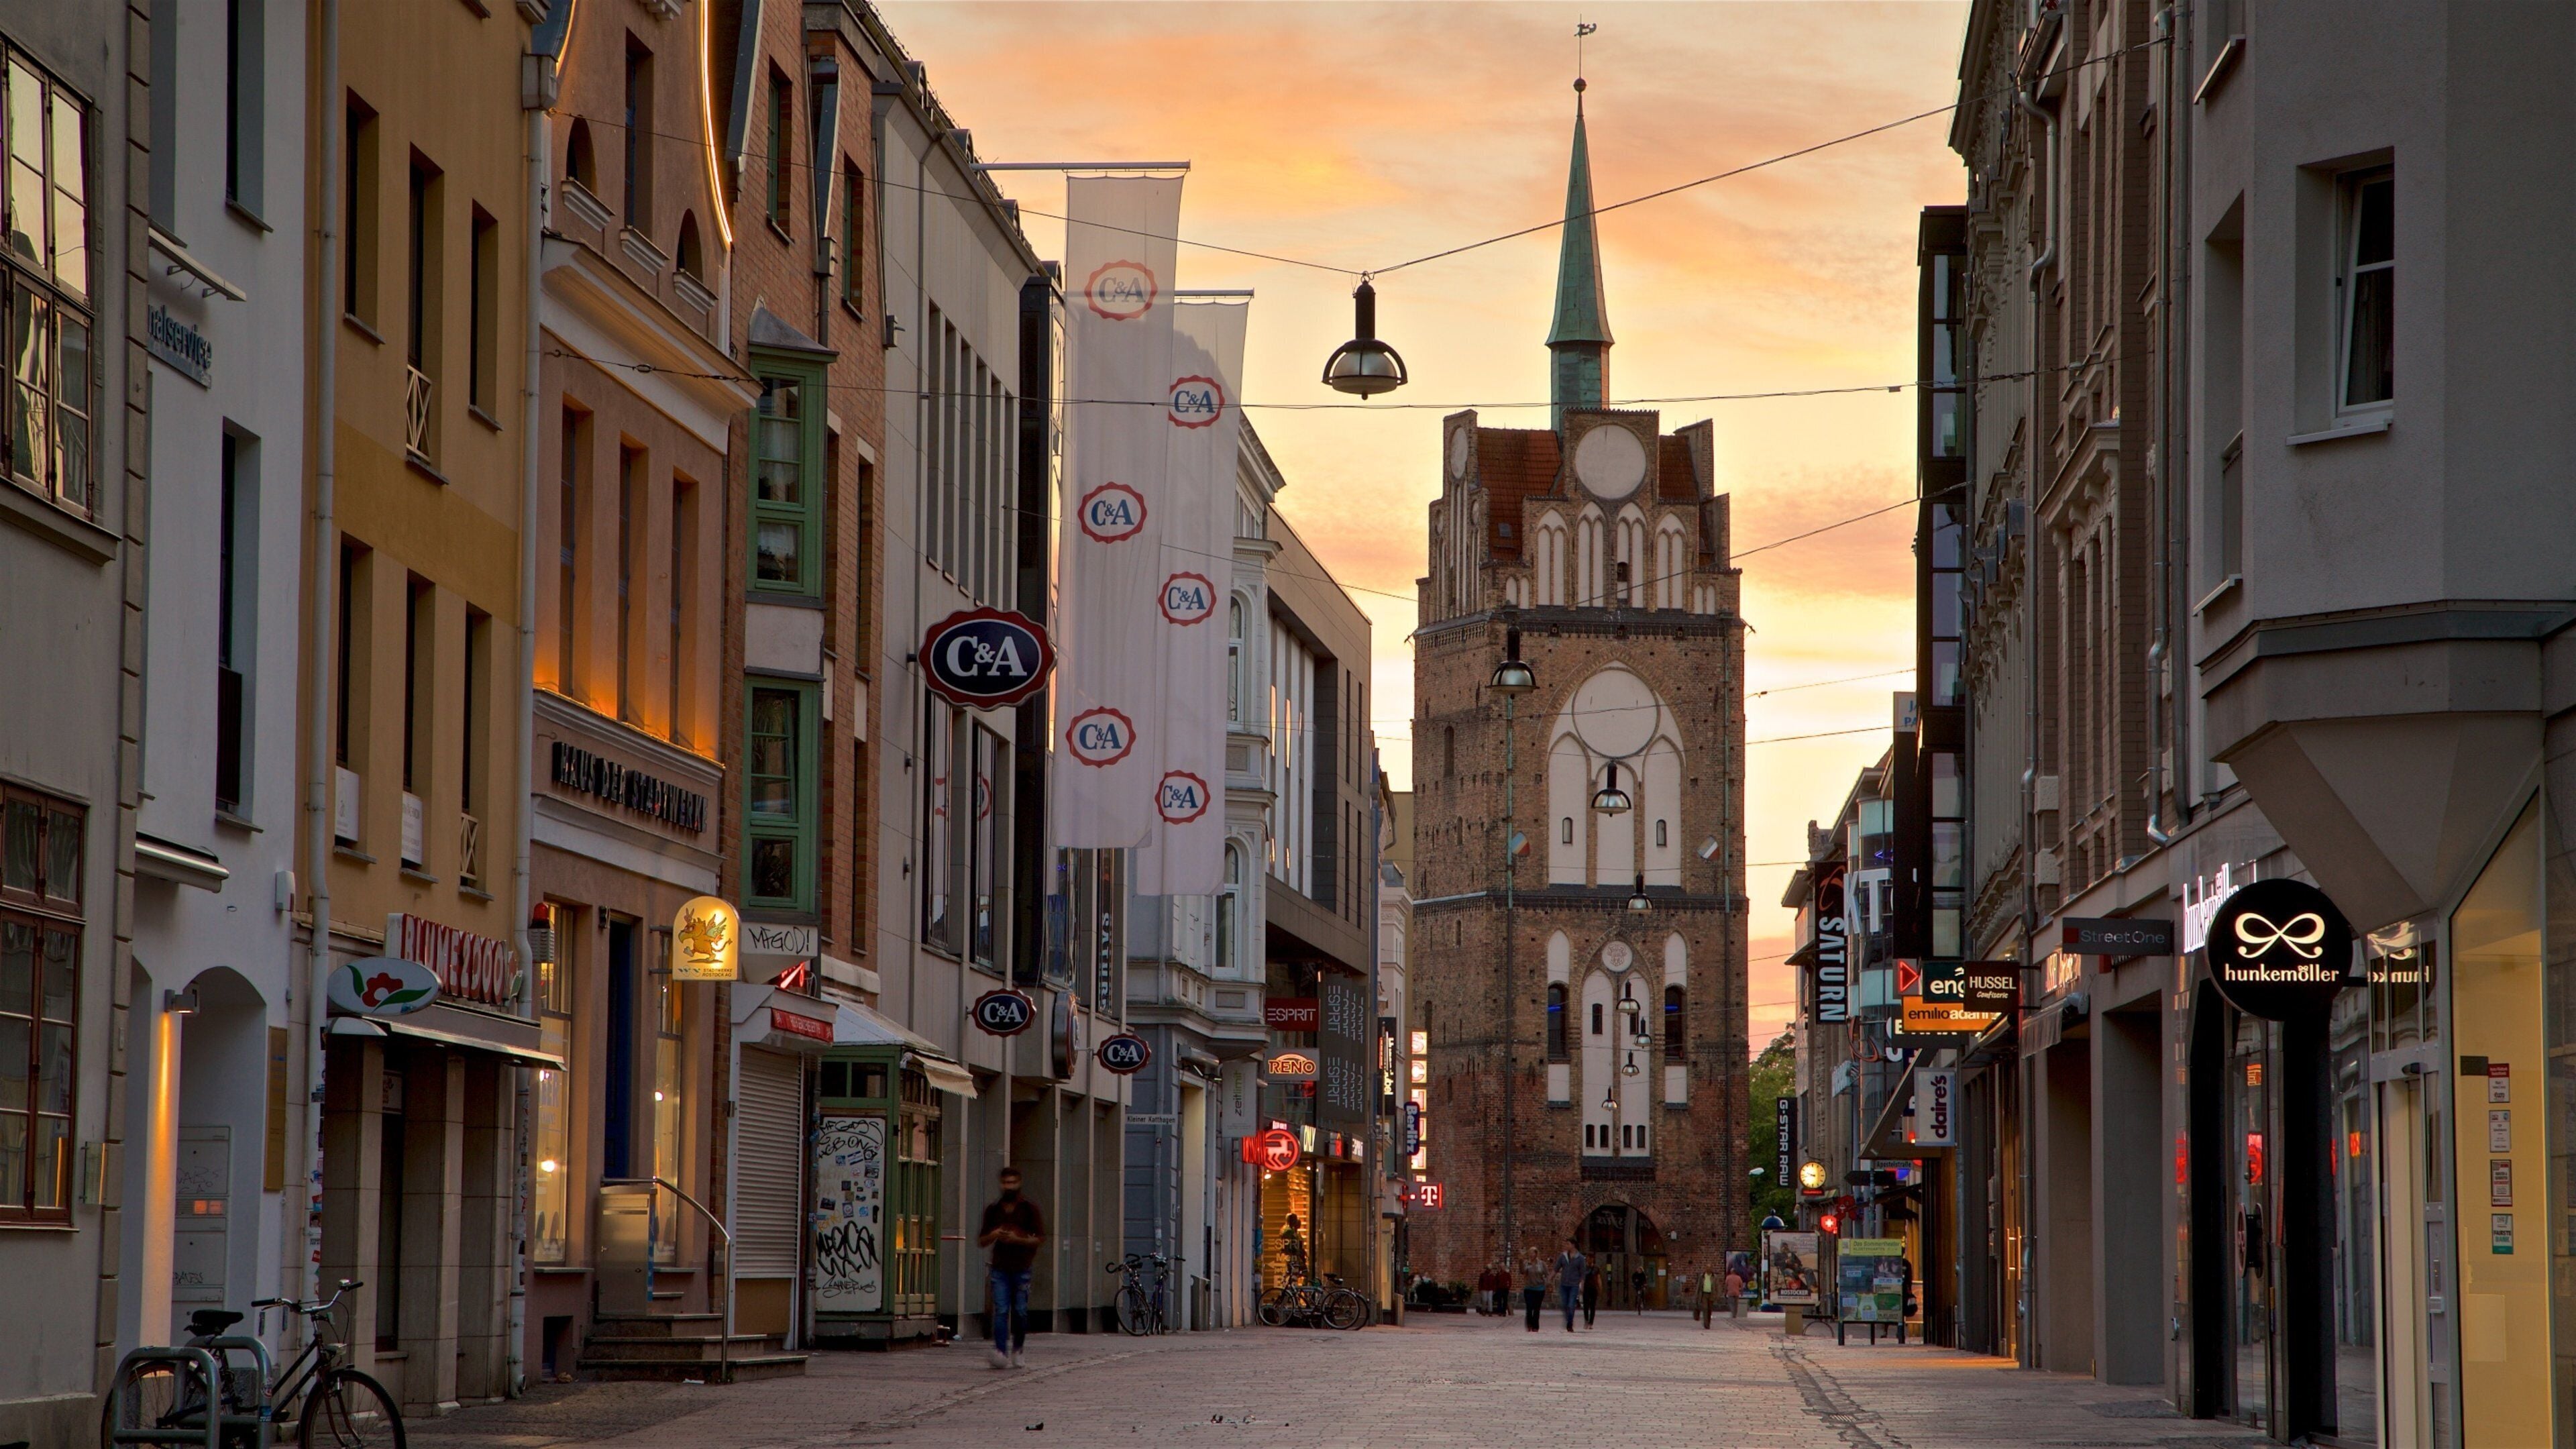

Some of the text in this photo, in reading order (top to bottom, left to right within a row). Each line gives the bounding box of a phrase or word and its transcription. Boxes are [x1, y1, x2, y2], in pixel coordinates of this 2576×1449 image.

[1098, 277, 1145, 303] C&A
[1174, 390, 1216, 413] C&A
[1091, 499, 1134, 526] C&A
[1168, 586, 1206, 610] C&A
[946, 635, 1028, 677] C&A
[1079, 723, 1122, 750] C&A
[553, 742, 708, 832] HAUS DER STADTWERKE
[1163, 785, 1198, 808] C&A
[1843, 868, 1893, 936] KT
[2183, 862, 2239, 953] hunkemöll
[1819, 916, 1845, 1021] SATURN
[2224, 963, 2340, 982] hunkemöller
[1930, 979, 1964, 998] eng
[1969, 976, 2017, 989] HUSSEL
[1976, 991, 2008, 999] Confiserie
[983, 1002, 1024, 1023] C&A
[1267, 1008, 1316, 1022] ESPRIT
[1328, 985, 1341, 1034] ESPRIT
[1107, 1044, 1140, 1062] C&A
[1268, 1059, 1316, 1075] RENO
[1234, 1070, 1242, 1117] zeitlimit
[1328, 1057, 1340, 1106] ESPRIT
[1931, 1075, 1947, 1138] claire's
[1148, 1116, 1175, 1124] Katthagen
[1406, 1105, 1418, 1153] Berlitz
[1779, 1155, 1789, 1186] RAW
[1876, 1160, 1912, 1168] Apostelstraße
